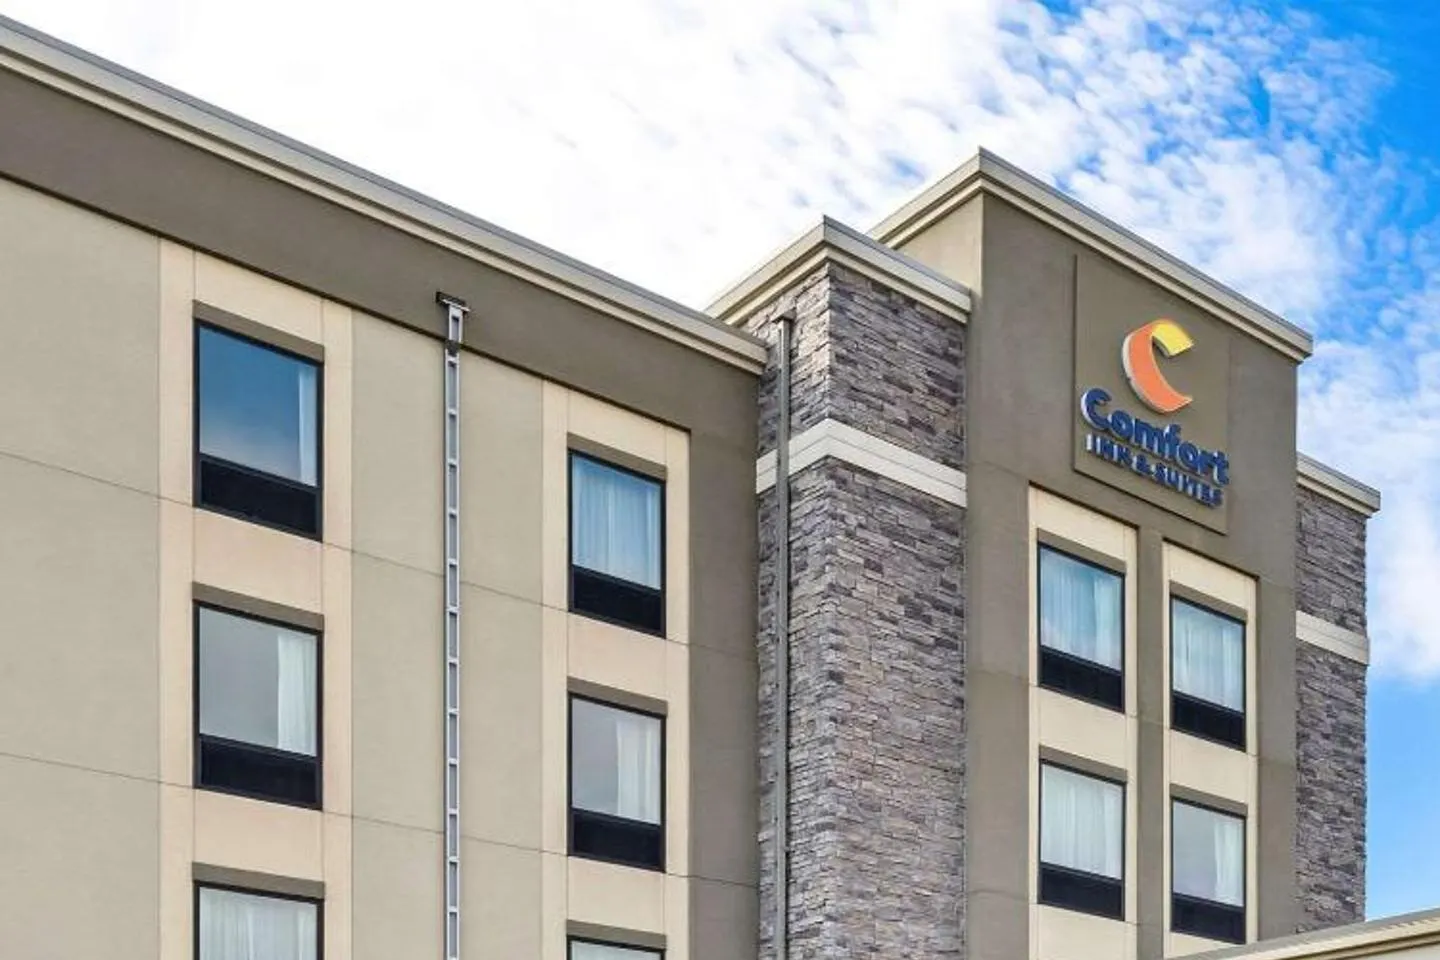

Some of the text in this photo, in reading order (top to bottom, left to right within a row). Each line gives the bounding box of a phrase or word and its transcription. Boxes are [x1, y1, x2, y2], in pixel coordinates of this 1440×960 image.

[1080, 387, 1229, 486] Comfort
[1085, 432, 1132, 465] INN
[1150, 462, 1224, 509] SUITES
